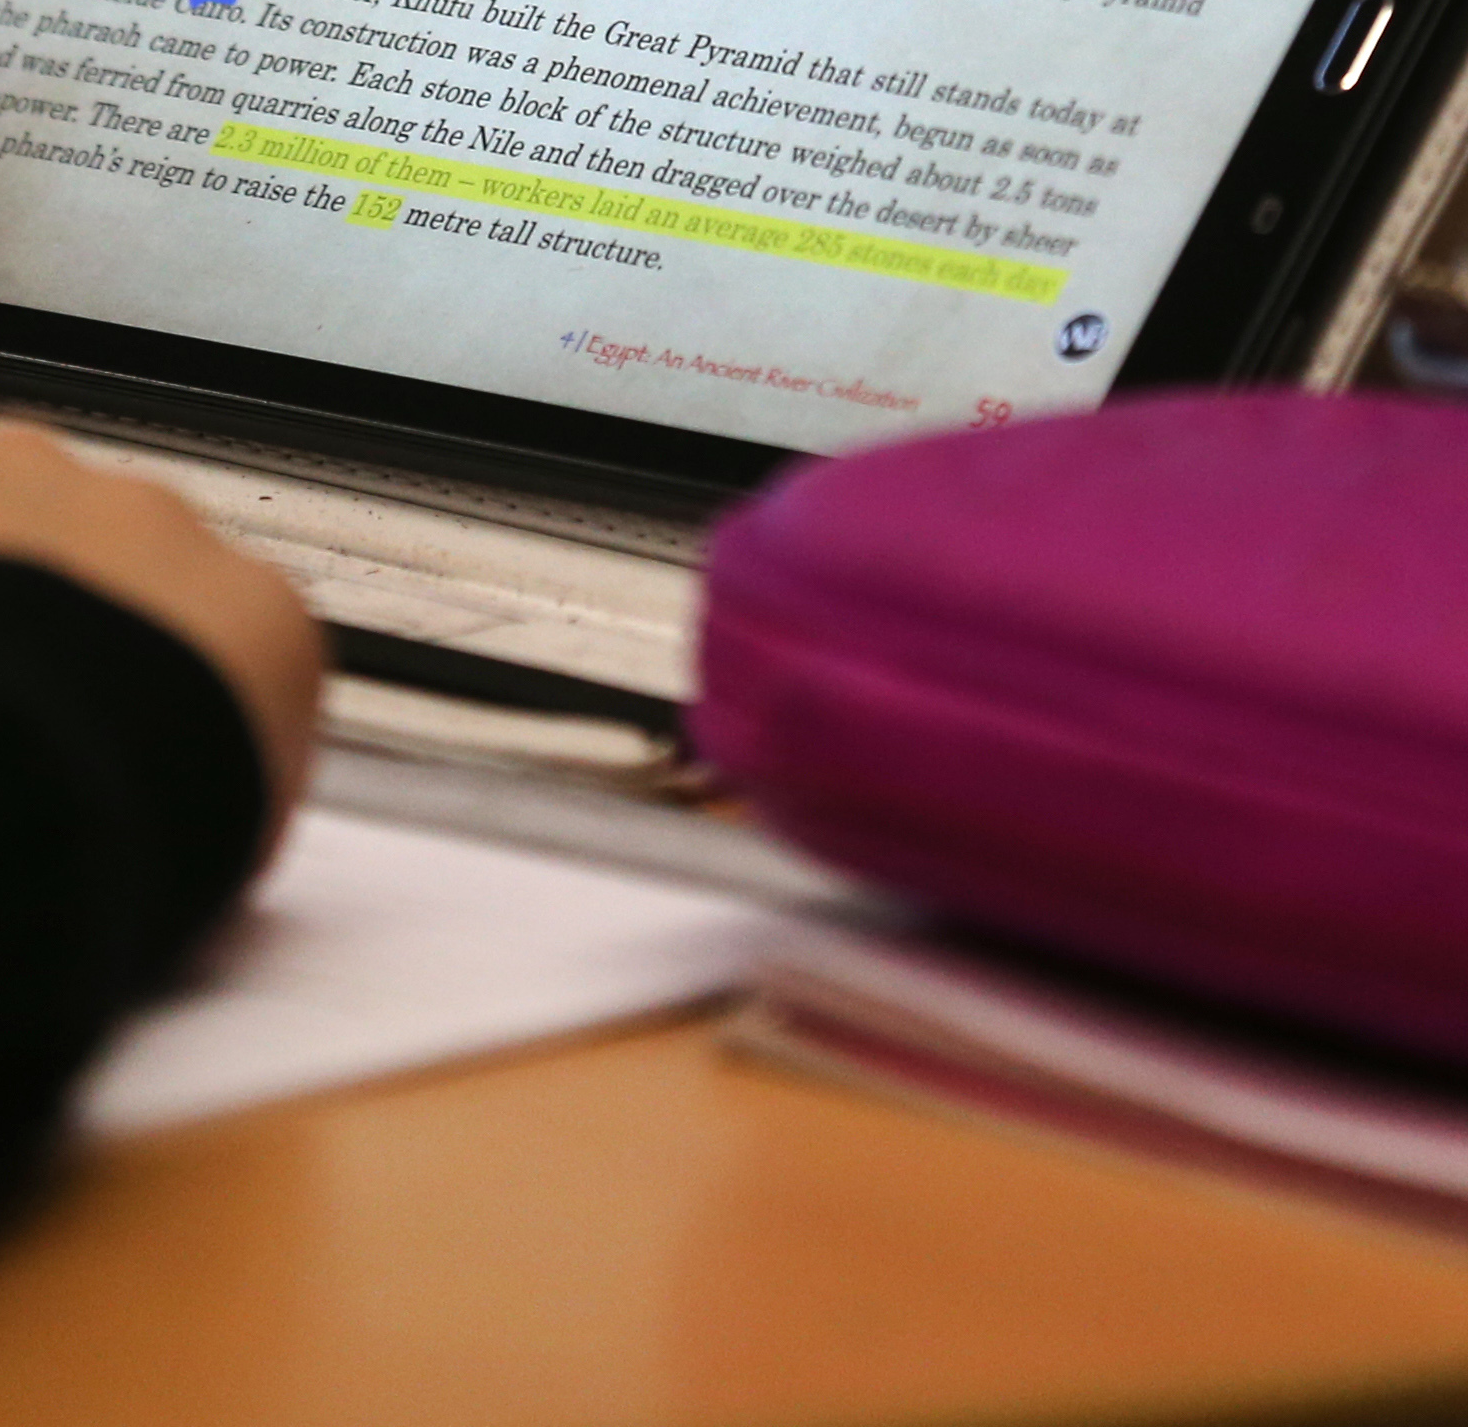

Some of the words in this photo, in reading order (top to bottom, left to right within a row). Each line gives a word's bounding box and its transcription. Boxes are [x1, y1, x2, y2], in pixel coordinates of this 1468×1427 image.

[30, 9, 142, 48] pharaoh
[147, 34, 217, 61] came
[251, 52, 338, 82] power.
[346, 60, 413, 95] Each
[419, 79, 492, 108] stone
[497, 86, 569, 122] block
[573, 103, 609, 128] of
[607, 107, 652, 136] the
[657, 121, 781, 160] structure
[790, 144, 903, 181] weighed
[903, 160, 983, 196] about
[987, 175, 1035, 205] 2.5
[1038, 186, 1098, 216] tons
[254, 1, 294, 31] Its
[298, 17, 458, 60] construction
[467, 45, 517, 70] was
[541, 54, 710, 103] phenomenal
[710, 85, 881, 137] achievement,
[892, 112, 975, 151] begun
[1017, 143, 1080, 170] soon
[551, 11, 596, 40] the
[603, 19, 680, 55] Great
[684, 33, 804, 76] Pyramid
[807, 55, 864, 87] that
[869, 70, 928, 98] still
[929, 83, 1021, 115] stands
[1027, 97, 1105, 134] today
[20, 53, 70, 78] was
[72, 56, 166, 94] ferried
[162, 71, 226, 105] from
[230, 91, 340, 125] quarries
[342, 105, 418, 144] along
[420, 117, 464, 147] the
[466, 124, 525, 158] Nile
[528, 142, 585, 167] and
[585, 146, 645, 179] then
[650, 157, 762, 199] dragged
[761, 185, 822, 210] over
[825, 189, 870, 219] the
[874, 197, 959, 235] desert
[1000, 222, 1079, 257] sheer
[88, 100, 163, 137] There
[165, 122, 211, 145] are
[212, 125, 258, 152] 2.3
[257, 135, 350, 170] million
[384, 154, 452, 188] them
[481, 177, 585, 211] workers
[587, 188, 645, 222] laid
[682, 215, 789, 250] average
[792, 228, 845, 258] 285
[125, 155, 195, 188] reign
[230, 174, 297, 204] raise
[302, 182, 346, 212] the
[351, 193, 402, 221] 152
[402, 207, 482, 236] metre
[487, 218, 538, 246] tall
[536, 230, 662, 270] structure.
[656, 347, 684, 369] An
[688, 353, 762, 384] Ancient
[762, 367, 816, 392] River
[968, 397, 1012, 428] 59
